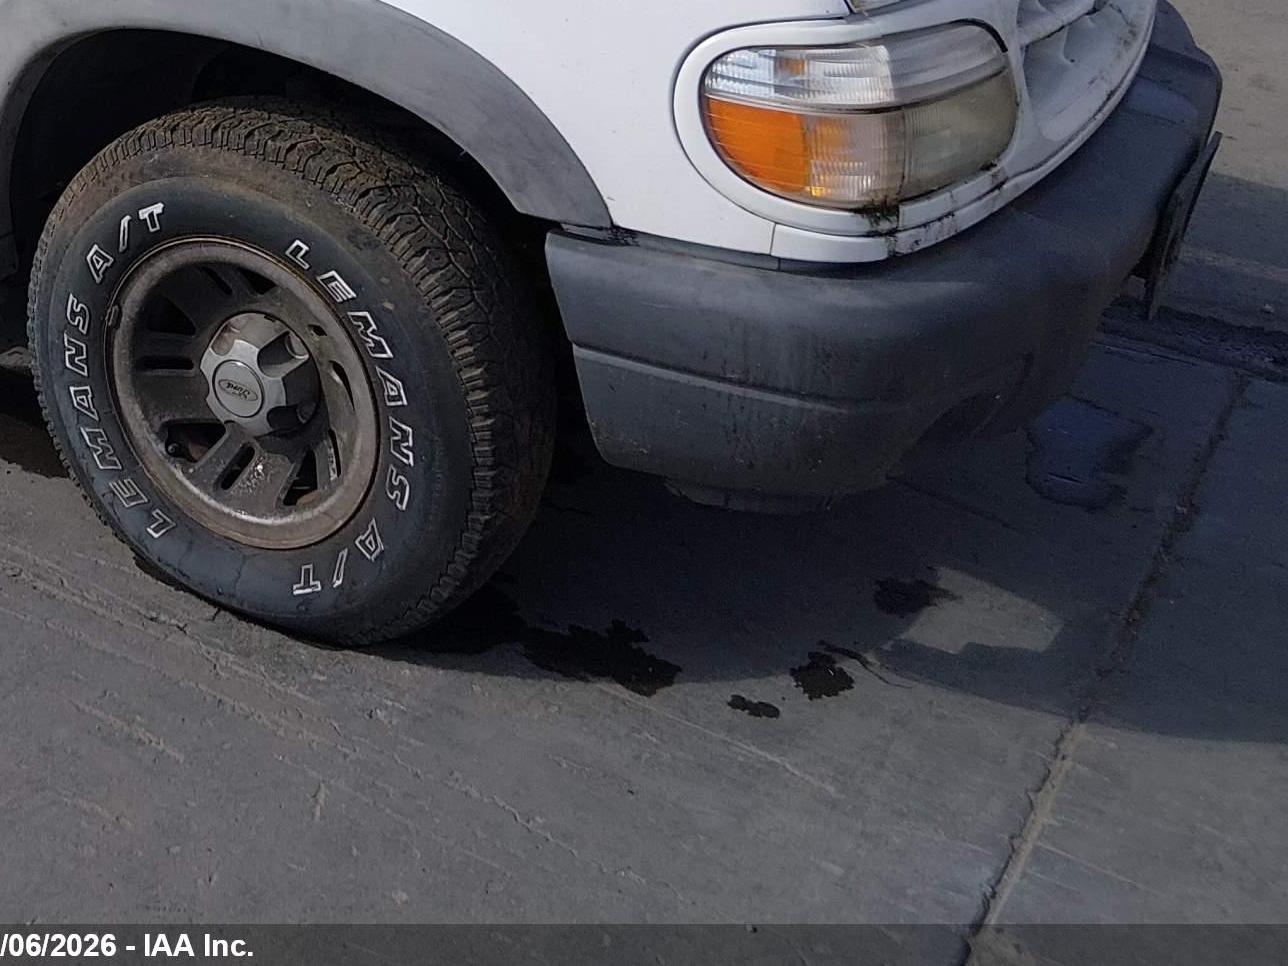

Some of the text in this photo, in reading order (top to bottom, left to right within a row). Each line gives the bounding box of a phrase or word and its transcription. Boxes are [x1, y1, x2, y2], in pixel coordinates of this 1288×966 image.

[64, 202, 178, 538] LEMANS A/T
[285, 239, 414, 596] LEMANS A/T
